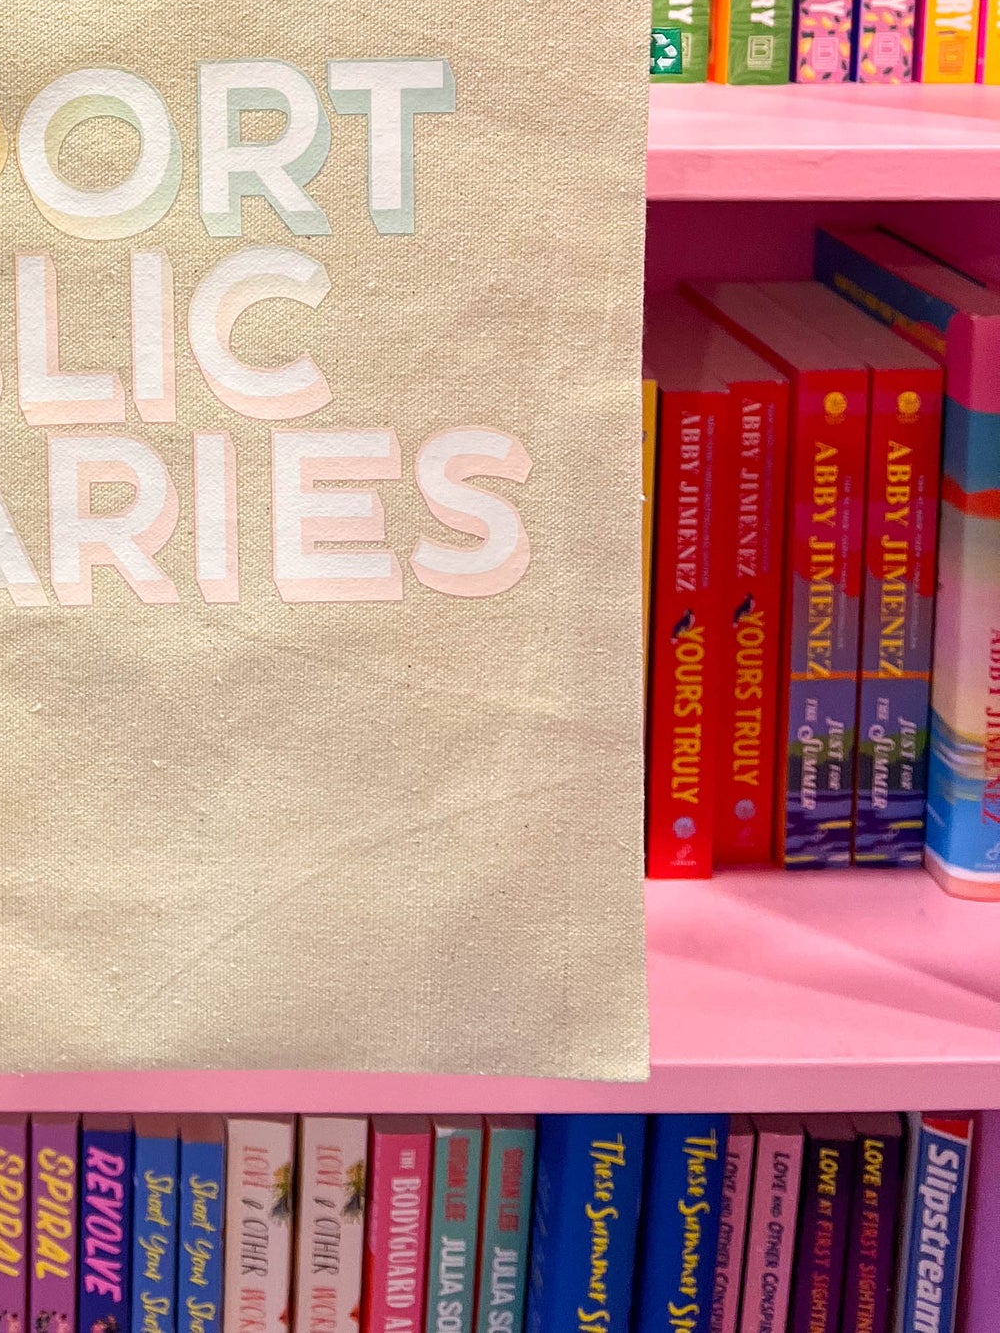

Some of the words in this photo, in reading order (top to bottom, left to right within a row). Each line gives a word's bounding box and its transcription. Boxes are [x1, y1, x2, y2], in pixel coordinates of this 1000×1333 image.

[679, 409, 702, 476] ABBY
[740, 396, 762, 462] ABBY
[735, 466, 760, 579] JIMENEZ
[811, 440, 840, 528] ABBY
[883, 439, 914, 528] ABBY
[674, 480, 700, 594] JIMENEZ
[673, 625, 706, 718] YOURS
[734, 610, 766, 700] YOURS
[670, 722, 702, 805] TRULY
[733, 706, 763, 787] TRULY
[400, 1148, 417, 1171] THE
[588, 1131, 626, 1202] These
[863, 1188, 879, 1207] AT
[36, 1147, 75, 1280] SPIRAL
[84, 1146, 126, 1304] REVOLVE
[241, 1218, 270, 1278] OTHER
[386, 1177, 422, 1308] BODYGUARD
[817, 1198, 833, 1218] AT
[438, 1235, 467, 1296] JULIA
[490, 1245, 519, 1306] JULIA
